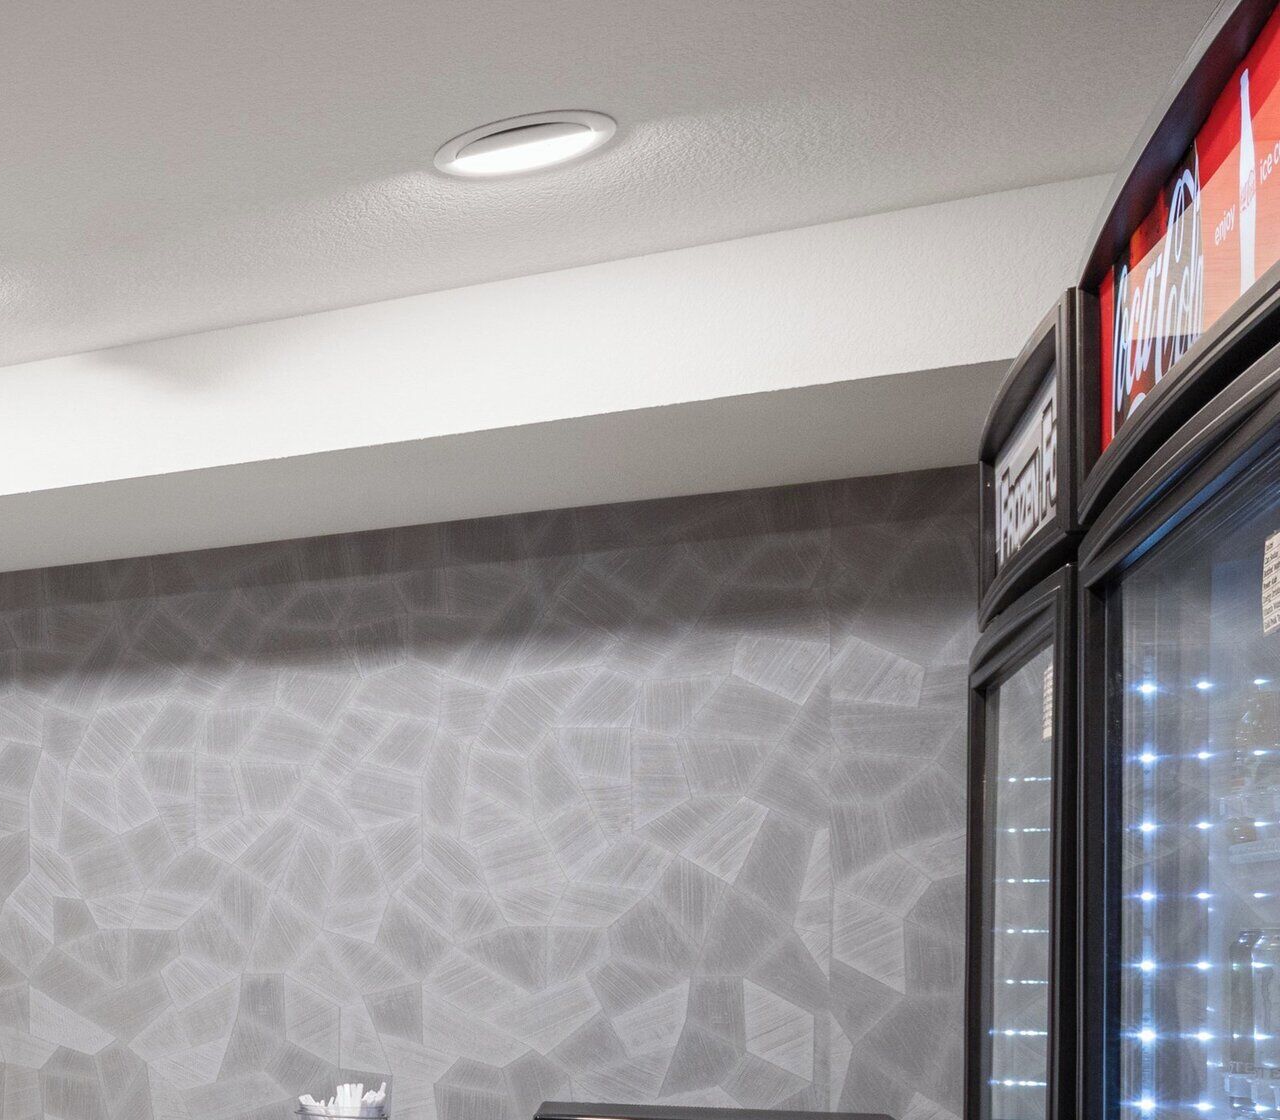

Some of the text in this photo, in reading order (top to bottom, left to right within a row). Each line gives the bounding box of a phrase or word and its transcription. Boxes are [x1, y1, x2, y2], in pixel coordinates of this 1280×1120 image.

[1215, 157, 1273, 246] enjoy ice
[1000, 450, 1041, 557] FROZEN
